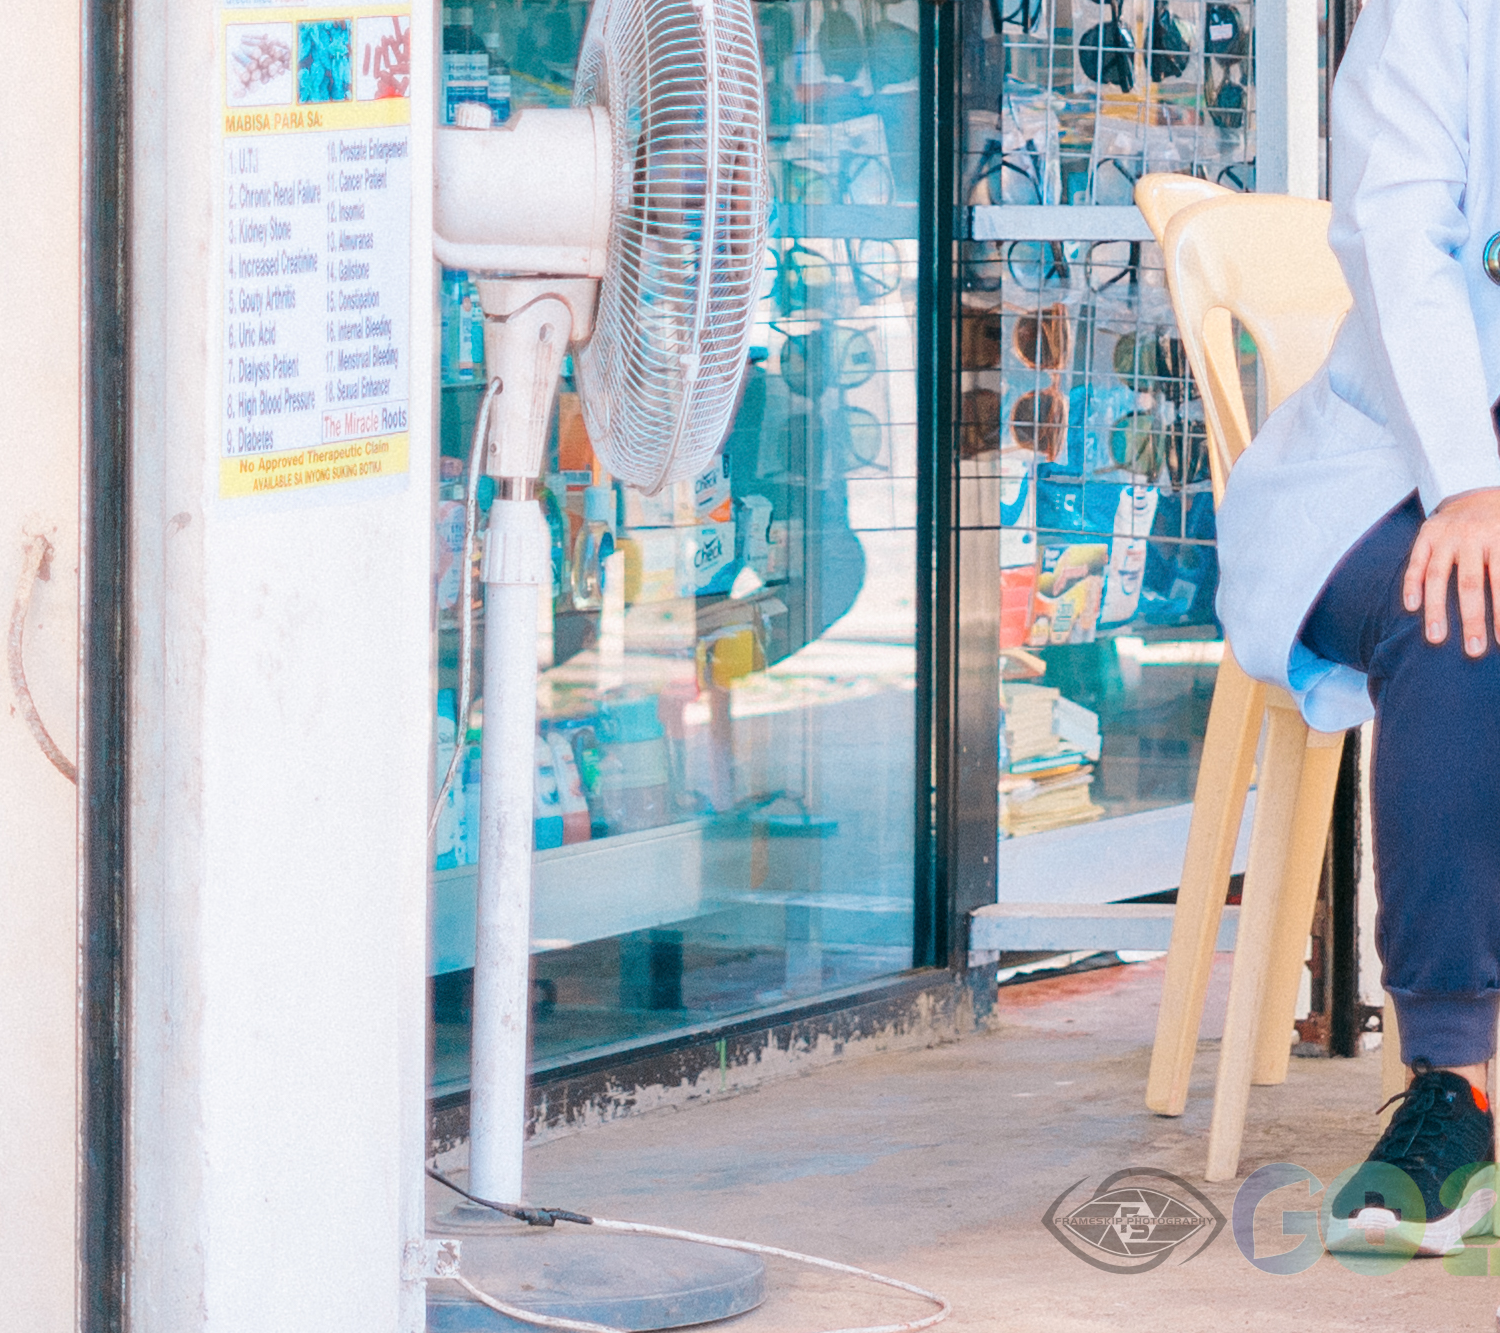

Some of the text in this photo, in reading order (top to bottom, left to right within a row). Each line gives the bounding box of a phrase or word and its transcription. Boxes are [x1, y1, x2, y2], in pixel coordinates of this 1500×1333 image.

[225, 112, 271, 132] MABISA
[274, 111, 304, 130] PARA
[239, 182, 271, 209] Chronic
[273, 180, 295, 207] Renal
[297, 179, 321, 204] Failure
[339, 169, 363, 192] Cancer
[365, 166, 387, 190] Patient
[239, 217, 267, 248] Kidney
[270, 215, 291, 241] Stone
[239, 249, 279, 279] Increased
[239, 287, 263, 317] Gouty
[239, 321, 255, 348] Uric
[258, 319, 276, 347] Acid
[238, 355, 270, 388] Dialysis
[238, 391, 257, 424] High
[260, 388, 282, 416] Blood
[284, 387, 315, 414] Pressure
[324, 406, 407, 438] The Miracle Roots
[238, 424, 274, 453] Diabetes
[239, 440, 390, 474] No Approved Therapeutic Claim
[253, 474, 292, 492] AVAILABLE
[294, 472, 303, 485] SA
[694, 538, 722, 567] Check
